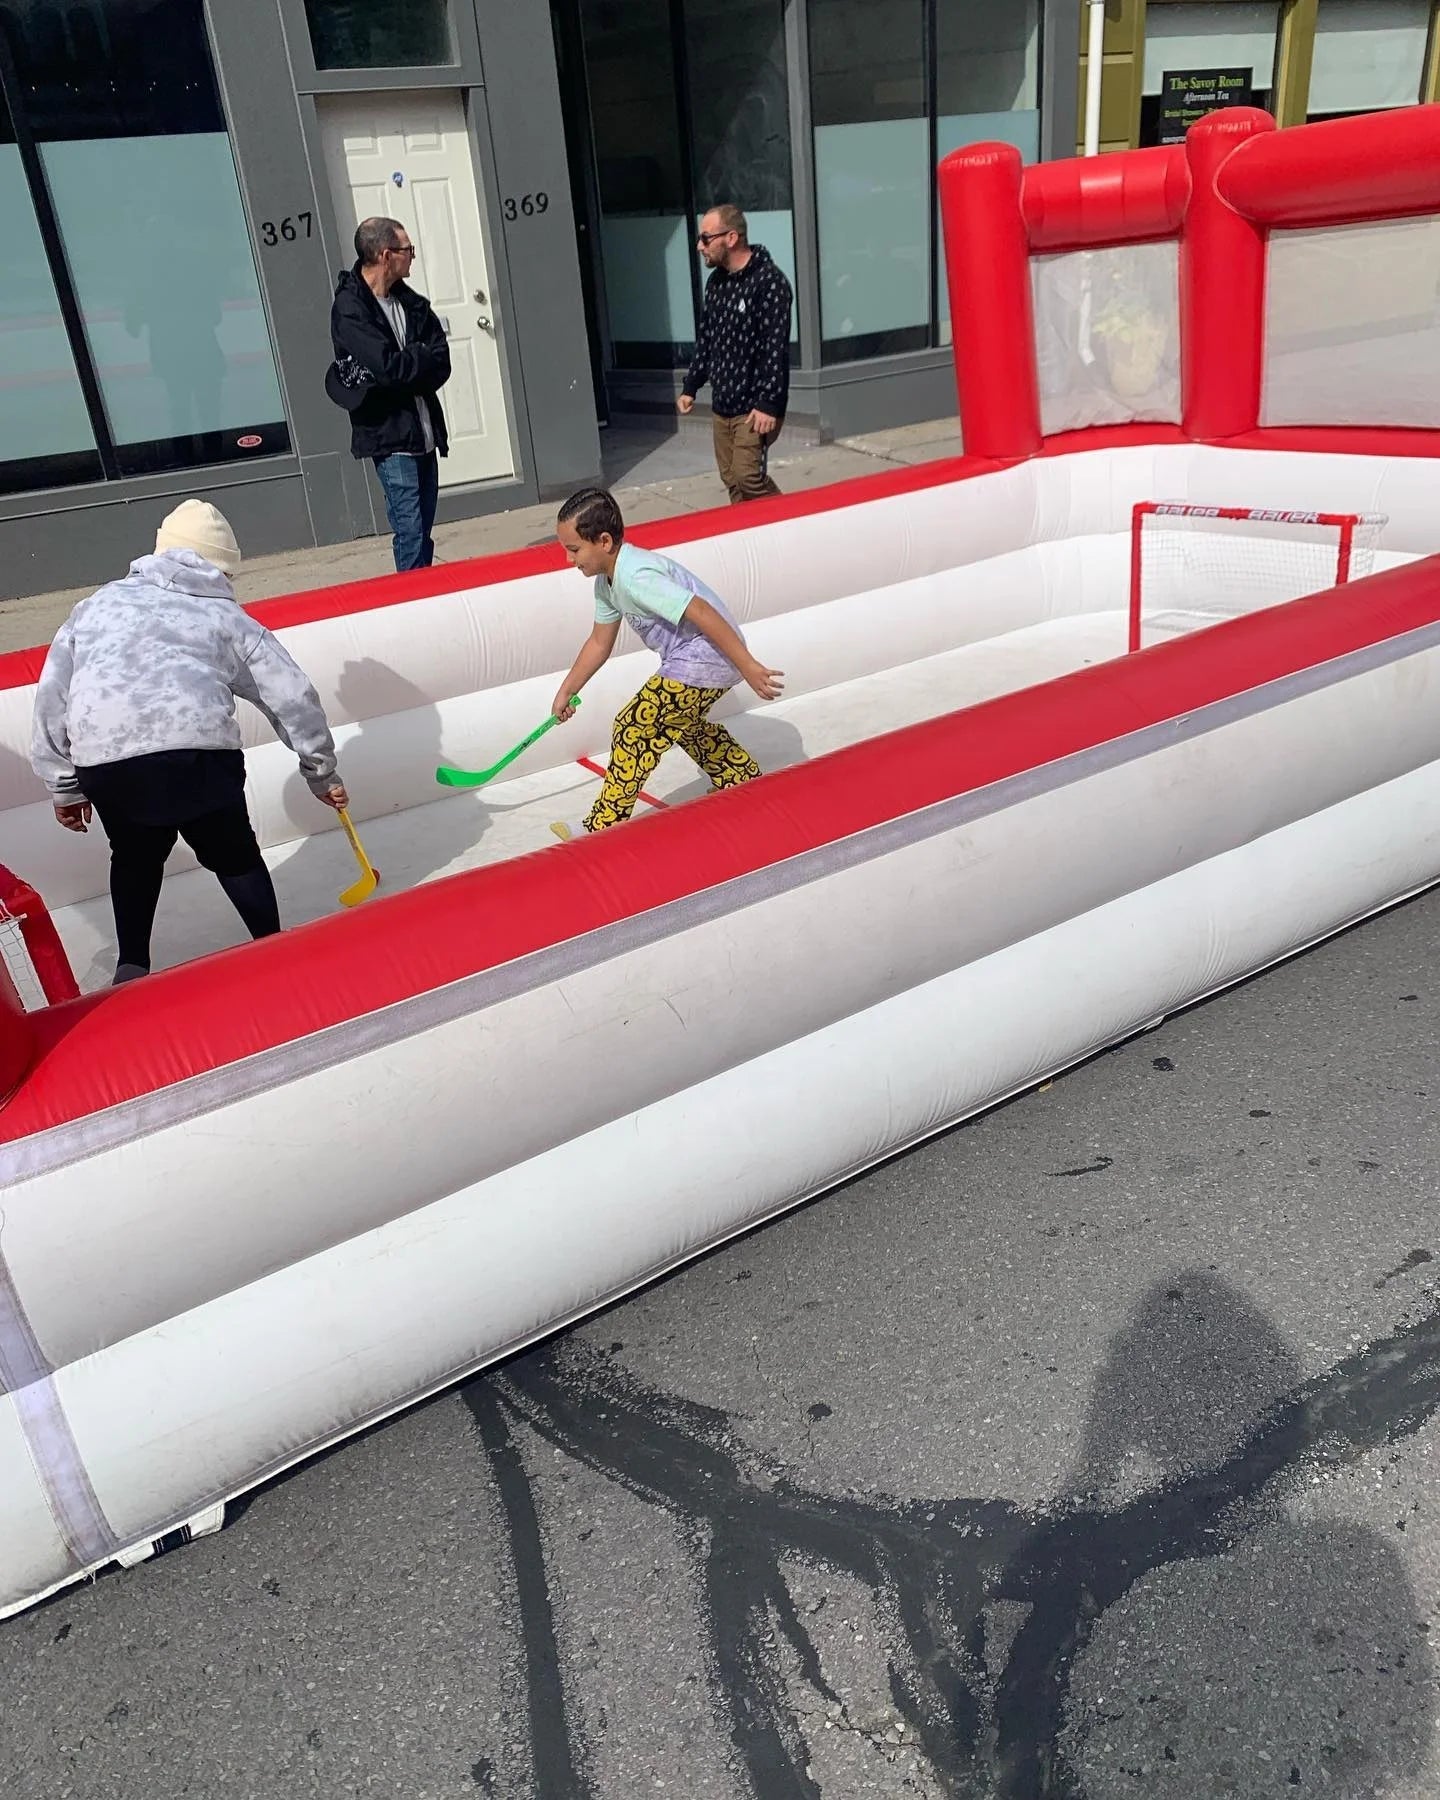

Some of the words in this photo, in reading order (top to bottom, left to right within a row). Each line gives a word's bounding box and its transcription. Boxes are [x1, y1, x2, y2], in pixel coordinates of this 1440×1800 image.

[1169, 77, 1188, 89] The
[1191, 77, 1216, 91] Savoy
[1219, 75, 1244, 87] Room
[1183, 92, 1215, 104] Afternoon
[1217, 91, 1229, 100] Tea
[504, 191, 549, 222] 369
[261, 211, 313, 246] 367
[1248, 509, 1319, 524] BAUER
